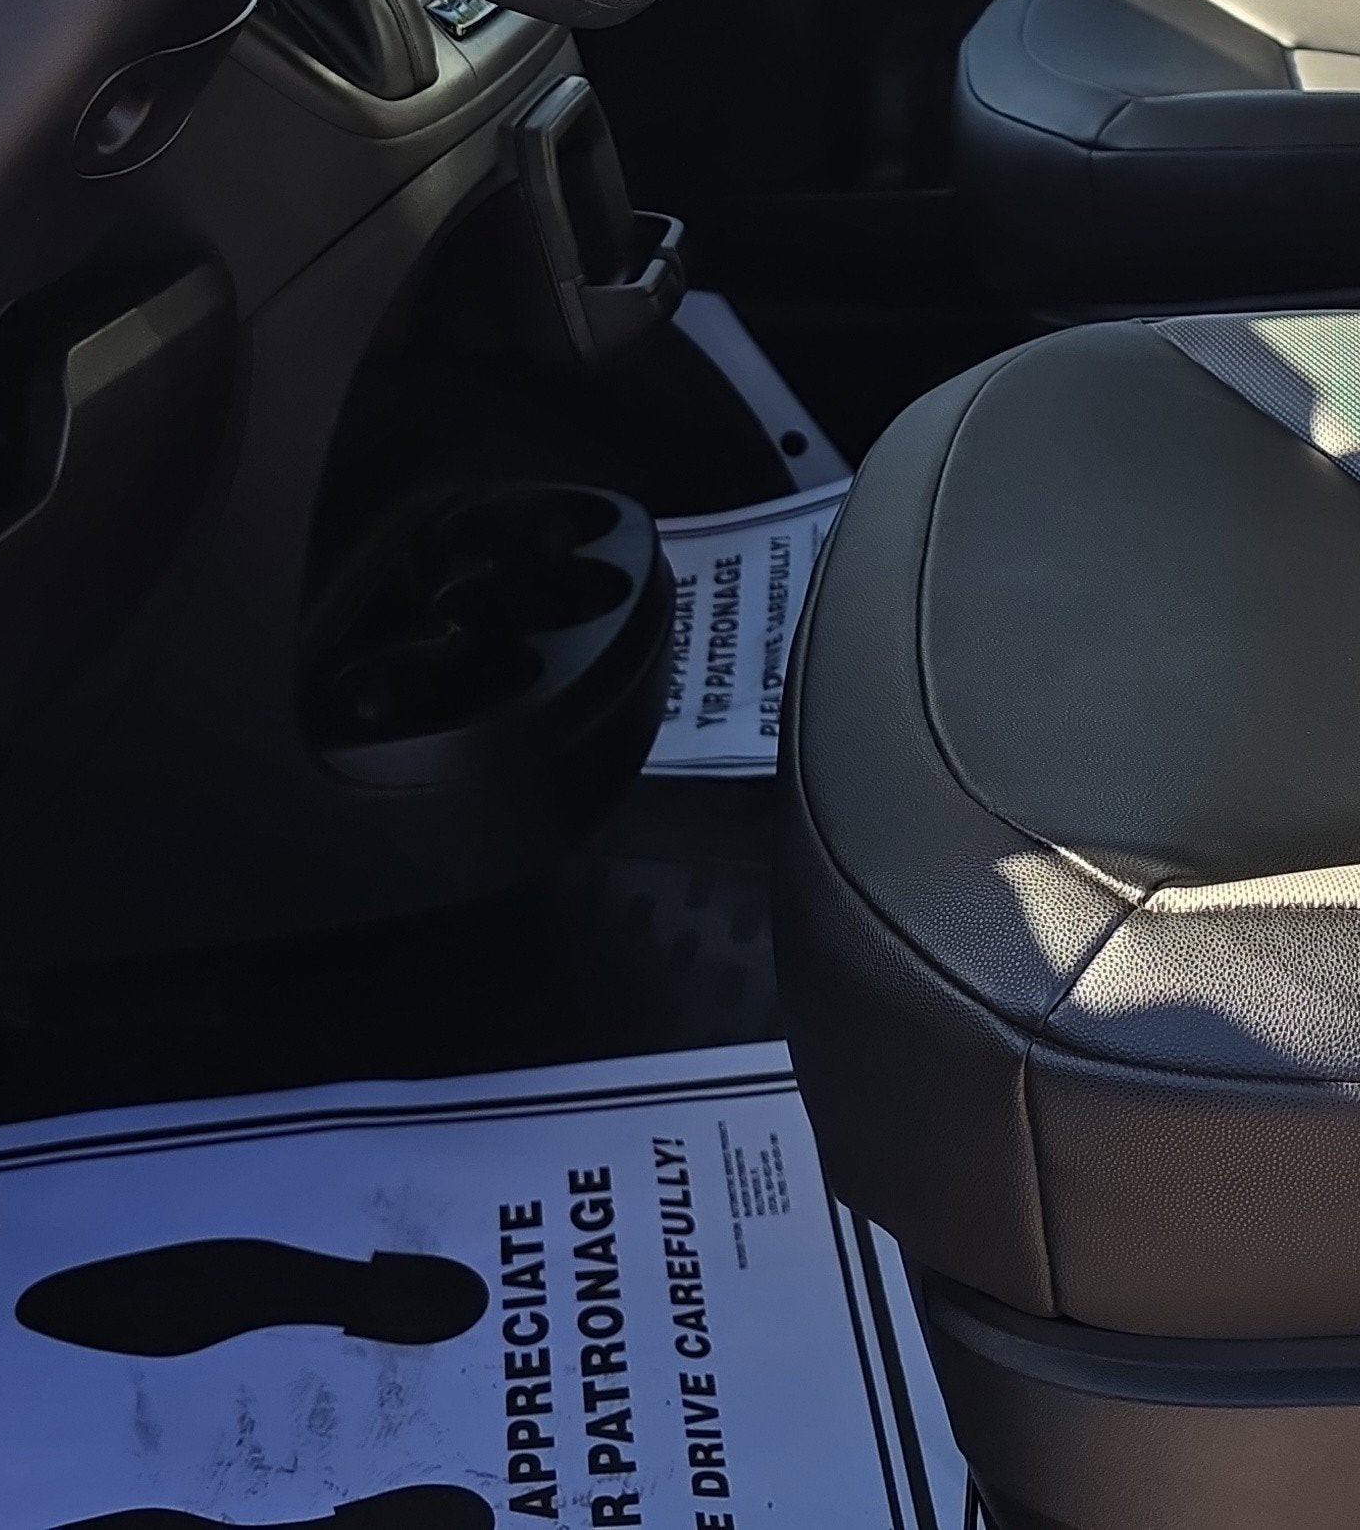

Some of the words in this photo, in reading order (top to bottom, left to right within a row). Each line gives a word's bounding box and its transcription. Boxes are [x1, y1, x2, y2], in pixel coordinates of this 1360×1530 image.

[705, 553, 742, 688] PATRONAGE
[499, 1199, 559, 1519] APPRECIATE
[568, 1166, 637, 1475] PATRONAGE
[652, 1136, 712, 1359] CAREFULLY!
[679, 1372, 730, 1498] DRIVE
